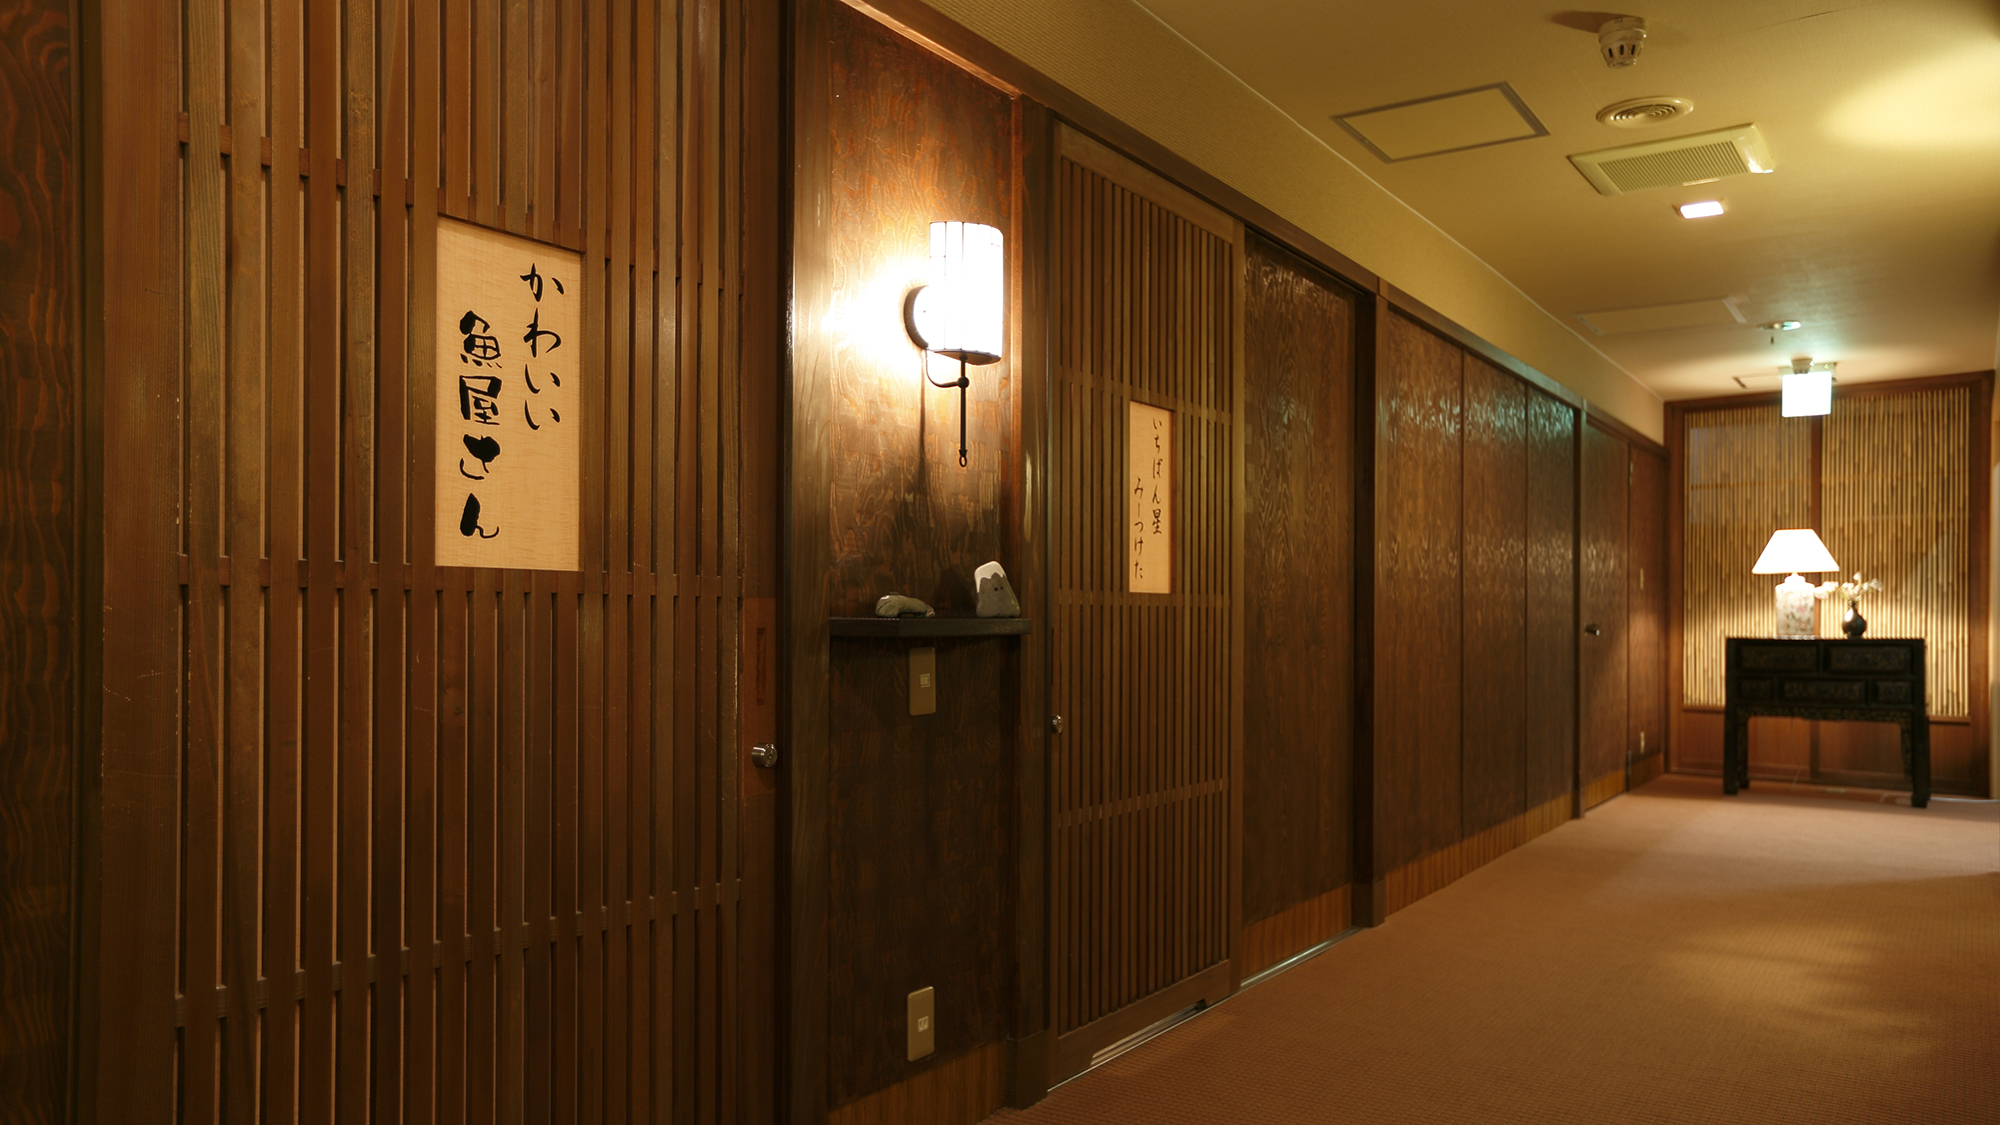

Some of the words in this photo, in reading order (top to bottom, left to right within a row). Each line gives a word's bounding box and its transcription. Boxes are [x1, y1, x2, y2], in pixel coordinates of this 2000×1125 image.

[519, 262, 565, 431] かわいい
[459, 309, 503, 540] 魚屋さん
[1152, 417, 1164, 535] いちばん星
[1134, 476, 1144, 580] みーつけた
